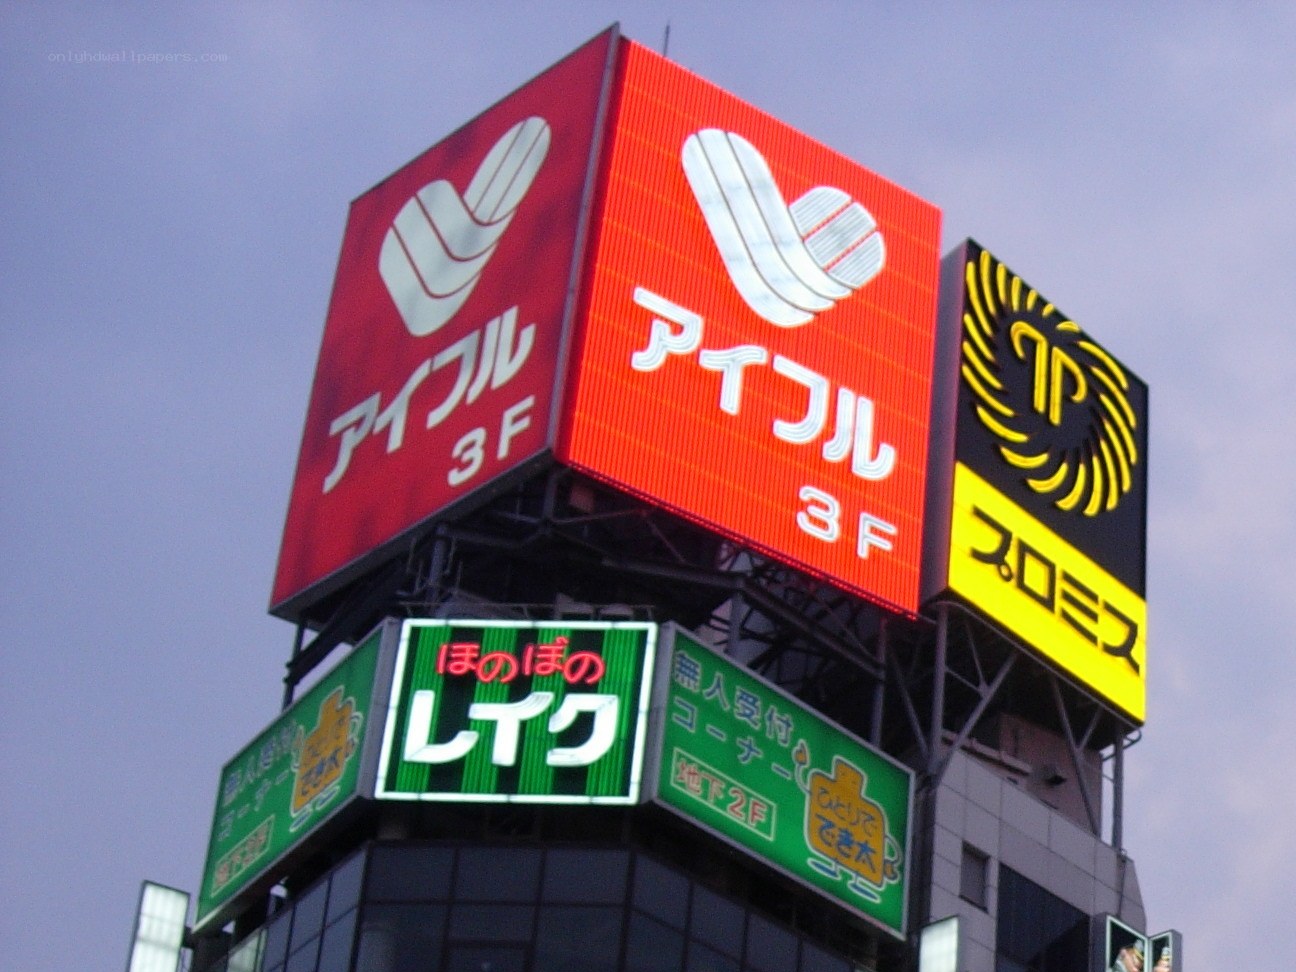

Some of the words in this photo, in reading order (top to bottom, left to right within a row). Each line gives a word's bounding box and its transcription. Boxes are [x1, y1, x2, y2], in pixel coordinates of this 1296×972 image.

[323, 306, 537, 493] アイフル
[632, 287, 897, 482] アイフル
[447, 396, 536, 487] 3F
[796, 486, 899, 560] 3F
[970, 507, 1140, 675] プロミス
[436, 637, 606, 685] ほのぼの
[675, 652, 793, 746] 無人受付
[402, 690, 619, 767] レイク
[672, 696, 792, 781] コーナー
[675, 757, 768, 828] 地下2F
